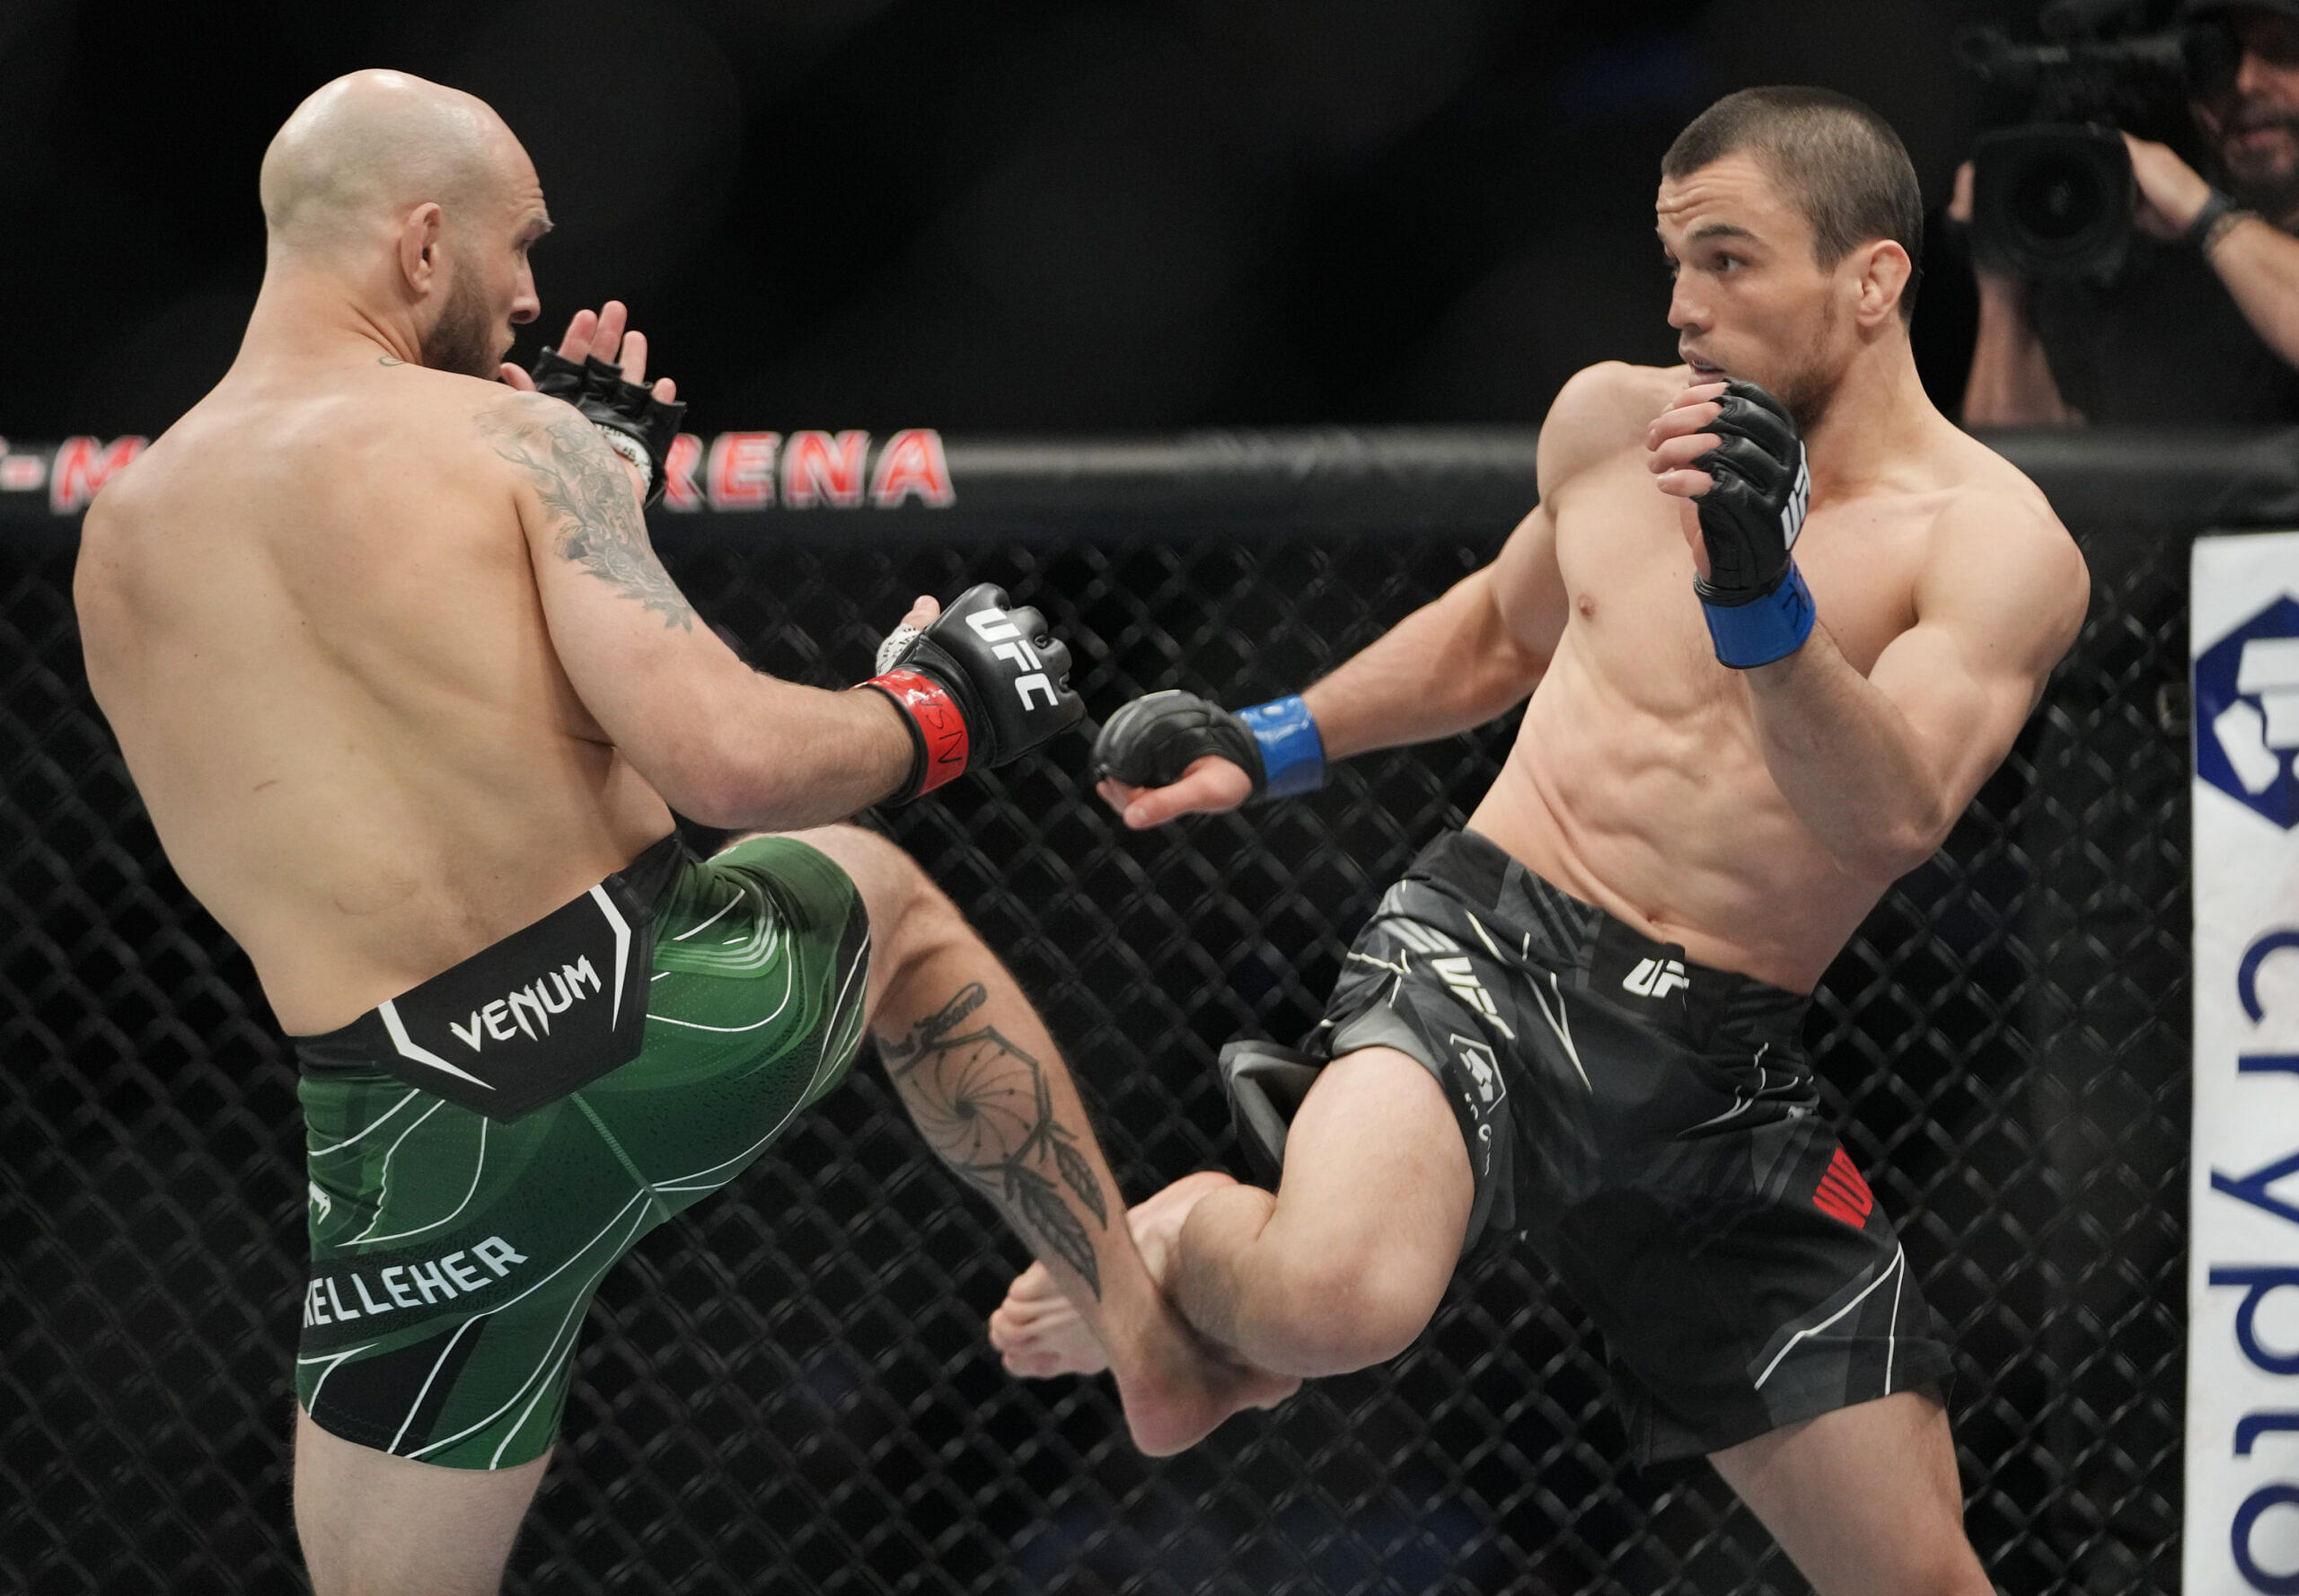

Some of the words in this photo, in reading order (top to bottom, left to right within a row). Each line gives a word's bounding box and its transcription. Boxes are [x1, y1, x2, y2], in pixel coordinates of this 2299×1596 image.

[663, 428, 957, 514] RENA
[965, 607, 1060, 712] UFC
[449, 954, 602, 1053] VENUM
[1622, 957, 1690, 1000] UF
[303, 1236, 529, 1328] KELLEHER
